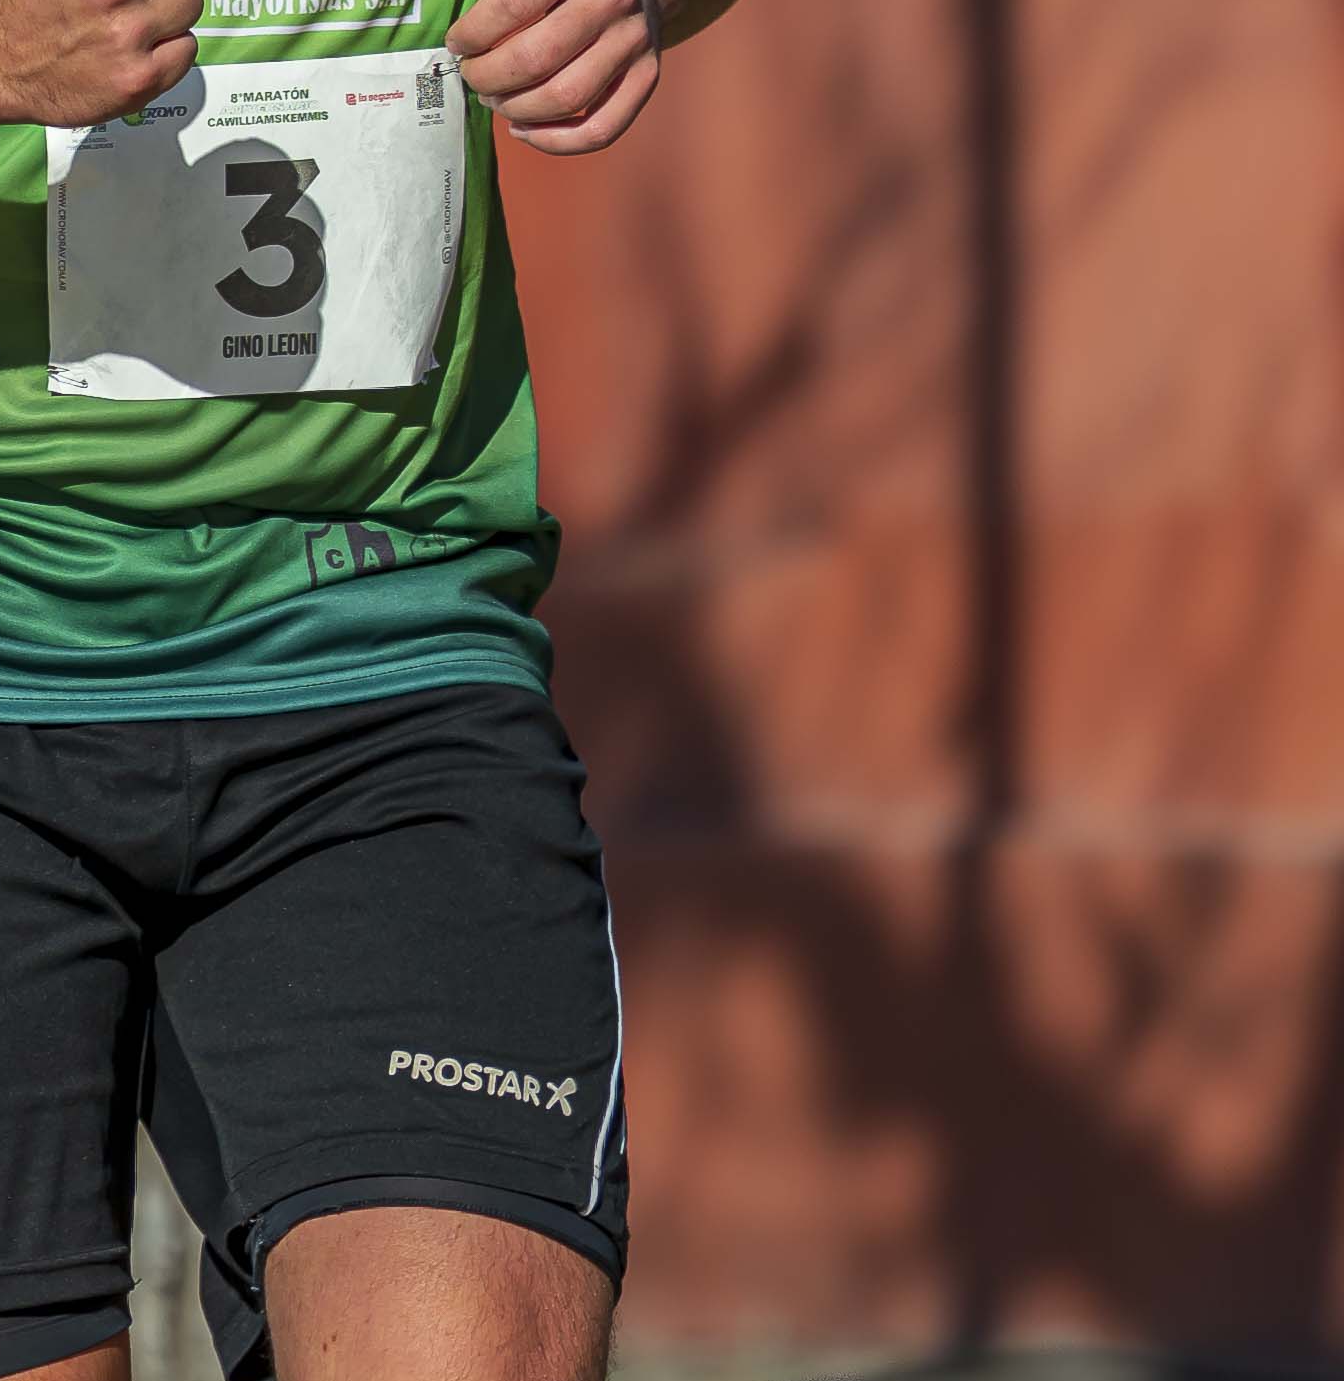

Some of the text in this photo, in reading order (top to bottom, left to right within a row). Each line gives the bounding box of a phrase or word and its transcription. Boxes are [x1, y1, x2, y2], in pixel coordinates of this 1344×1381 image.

[207, 111, 329, 127] CAWILLIAMSKEMMIS
[214, 158, 327, 319] 3
[222, 333, 317, 358] GINO LEONI
[388, 1050, 540, 1107] PROSTAR
